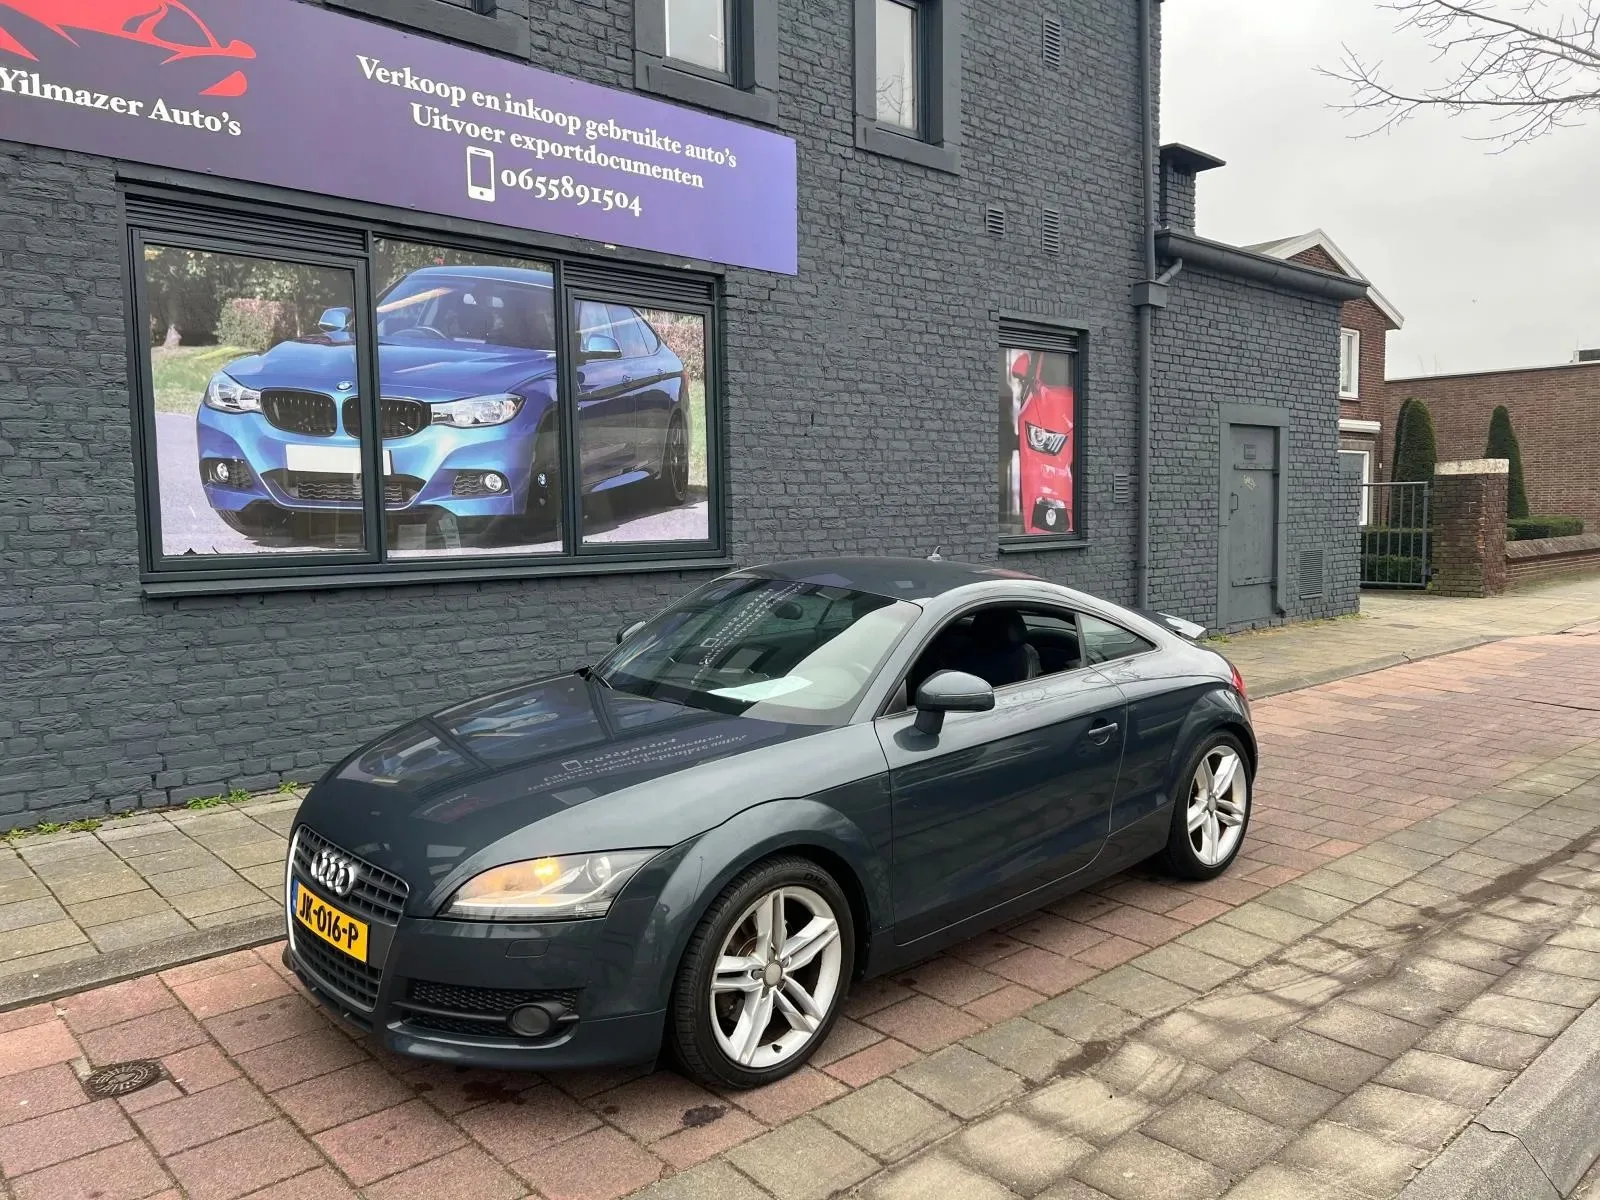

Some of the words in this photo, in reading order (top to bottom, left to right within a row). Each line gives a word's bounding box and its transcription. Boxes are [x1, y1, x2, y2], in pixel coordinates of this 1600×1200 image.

[0, 66, 144, 117] Yilmazer
[148, 98, 242, 136] Auto's
[355, 54, 467, 108] Verkoop
[472, 91, 501, 112] en
[505, 92, 582, 136] inkoop
[585, 119, 682, 155] gebruikte
[685, 143, 737, 168] auto's
[409, 102, 506, 144] Uitvoer
[509, 133, 705, 189] exportdocumenten
[500, 169, 643, 217] 0655891504
[299, 892, 360, 950] JK-016-P
